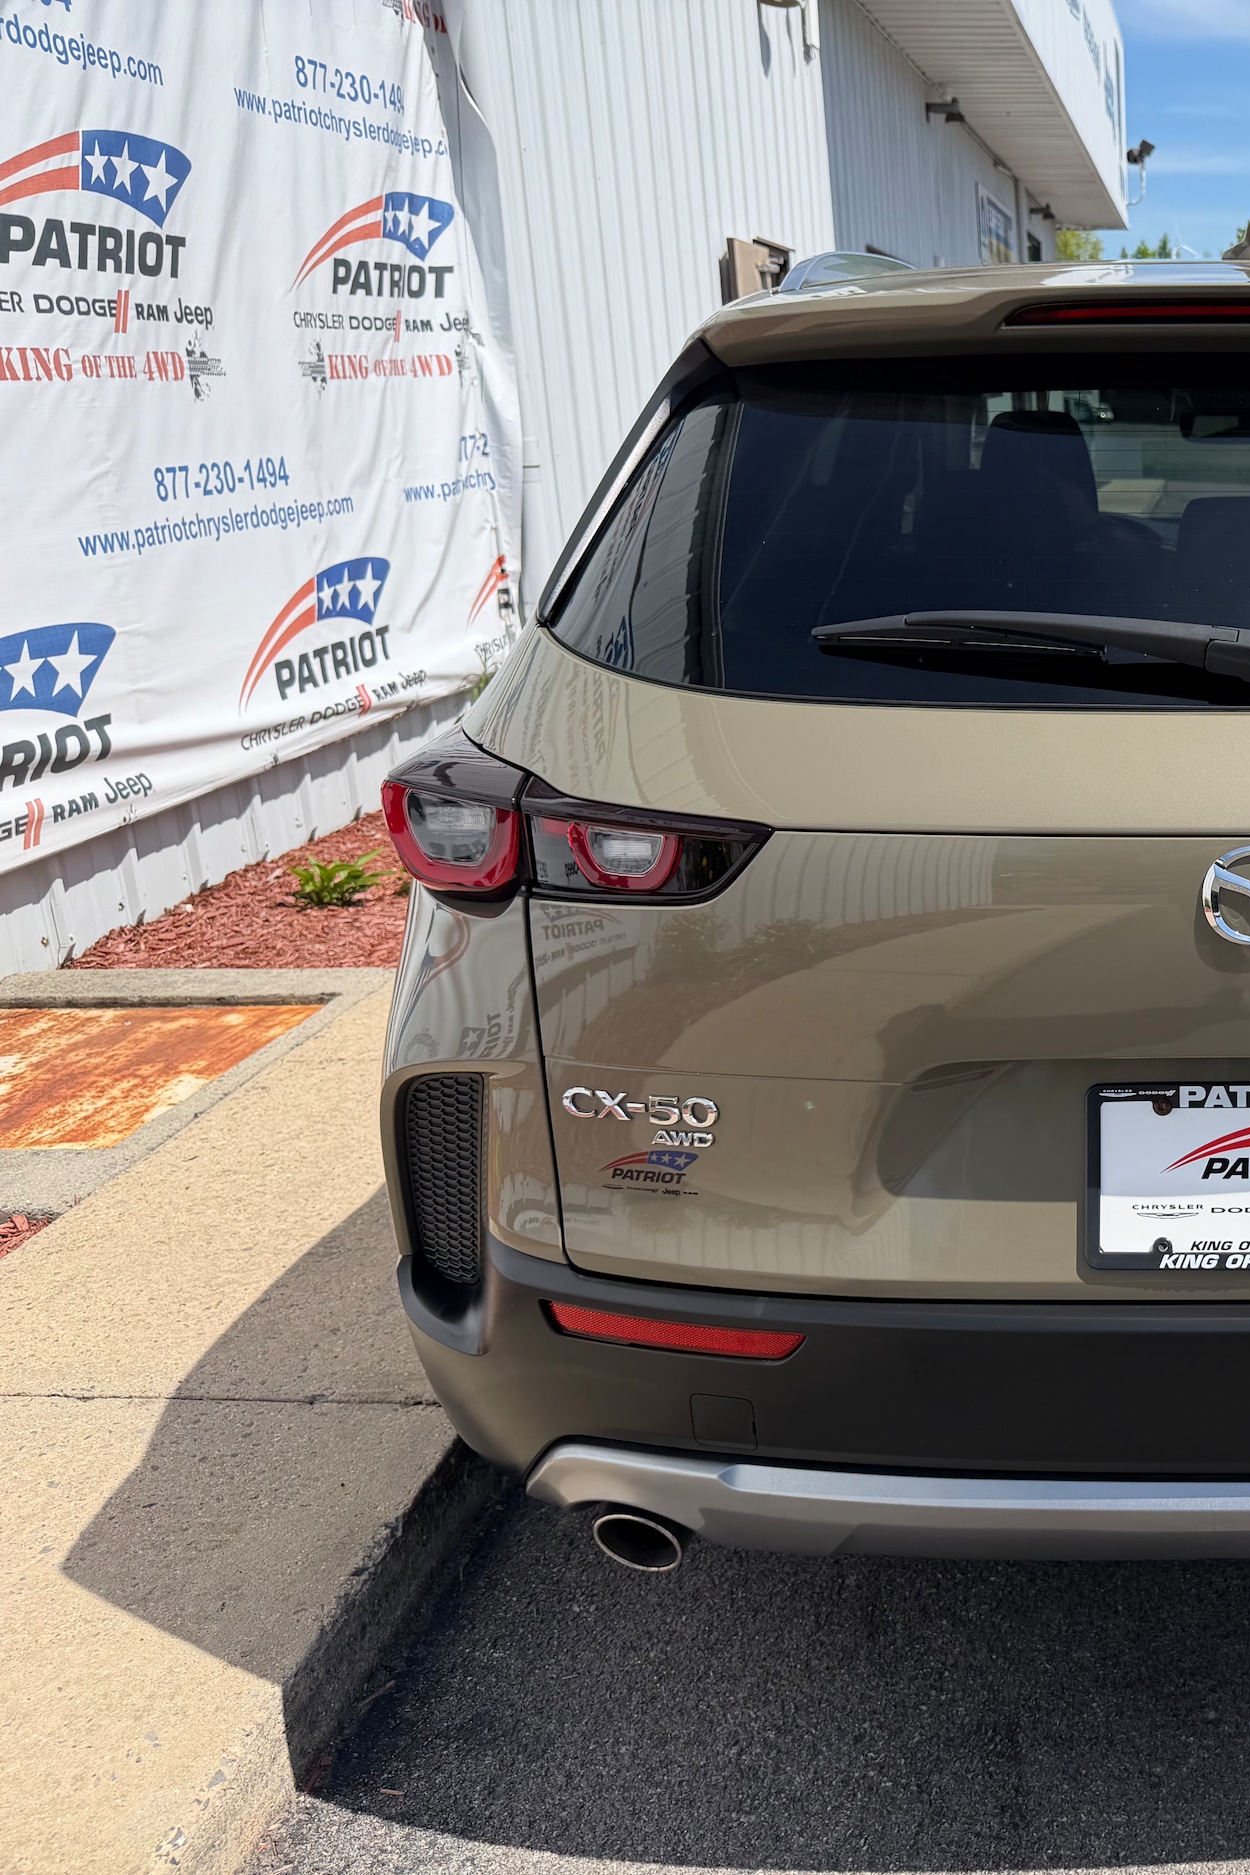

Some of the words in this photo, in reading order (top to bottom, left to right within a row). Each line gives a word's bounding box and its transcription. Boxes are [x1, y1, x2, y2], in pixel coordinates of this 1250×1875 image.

[294, 55, 405, 116] 877-230-149
[0, 212, 186, 279] PATRIOT
[332, 257, 454, 299] PATRIOT
[33, 293, 117, 318] DODGE
[135, 302, 170, 322] RAM
[174, 297, 213, 330] Jeep
[293, 311, 345, 330] CHRYSLER
[405, 319, 434, 332] RAM
[0, 346, 73, 382] KING
[81, 354, 102, 379] OF
[104, 355, 137, 379] THE
[143, 351, 185, 381] 4WD
[327, 354, 369, 380] KING
[410, 354, 453, 378] 4WD
[154, 456, 289, 502] 877-230-1494
[78, 496, 354, 557] www.patriotchryslerdodgejeep.com
[275, 624, 390, 701] PATRIOT
[241, 716, 304, 751] CHRYSLER
[372, 681, 398, 702] RAM
[399, 669, 427, 692] Jeep
[52, 792, 99, 824] RAM
[104, 772, 153, 804] Jeep
[562, 1086, 719, 1129] CX-50
[651, 1129, 716, 1149] AWD
[611, 1167, 686, 1184] PATRIOT
[662, 1187, 680, 1197] Jeep
[1132, 1203, 1204, 1211] CHRYSLER
[1159, 1253, 1217, 1269] KING
[1190, 1240, 1233, 1251] KING
